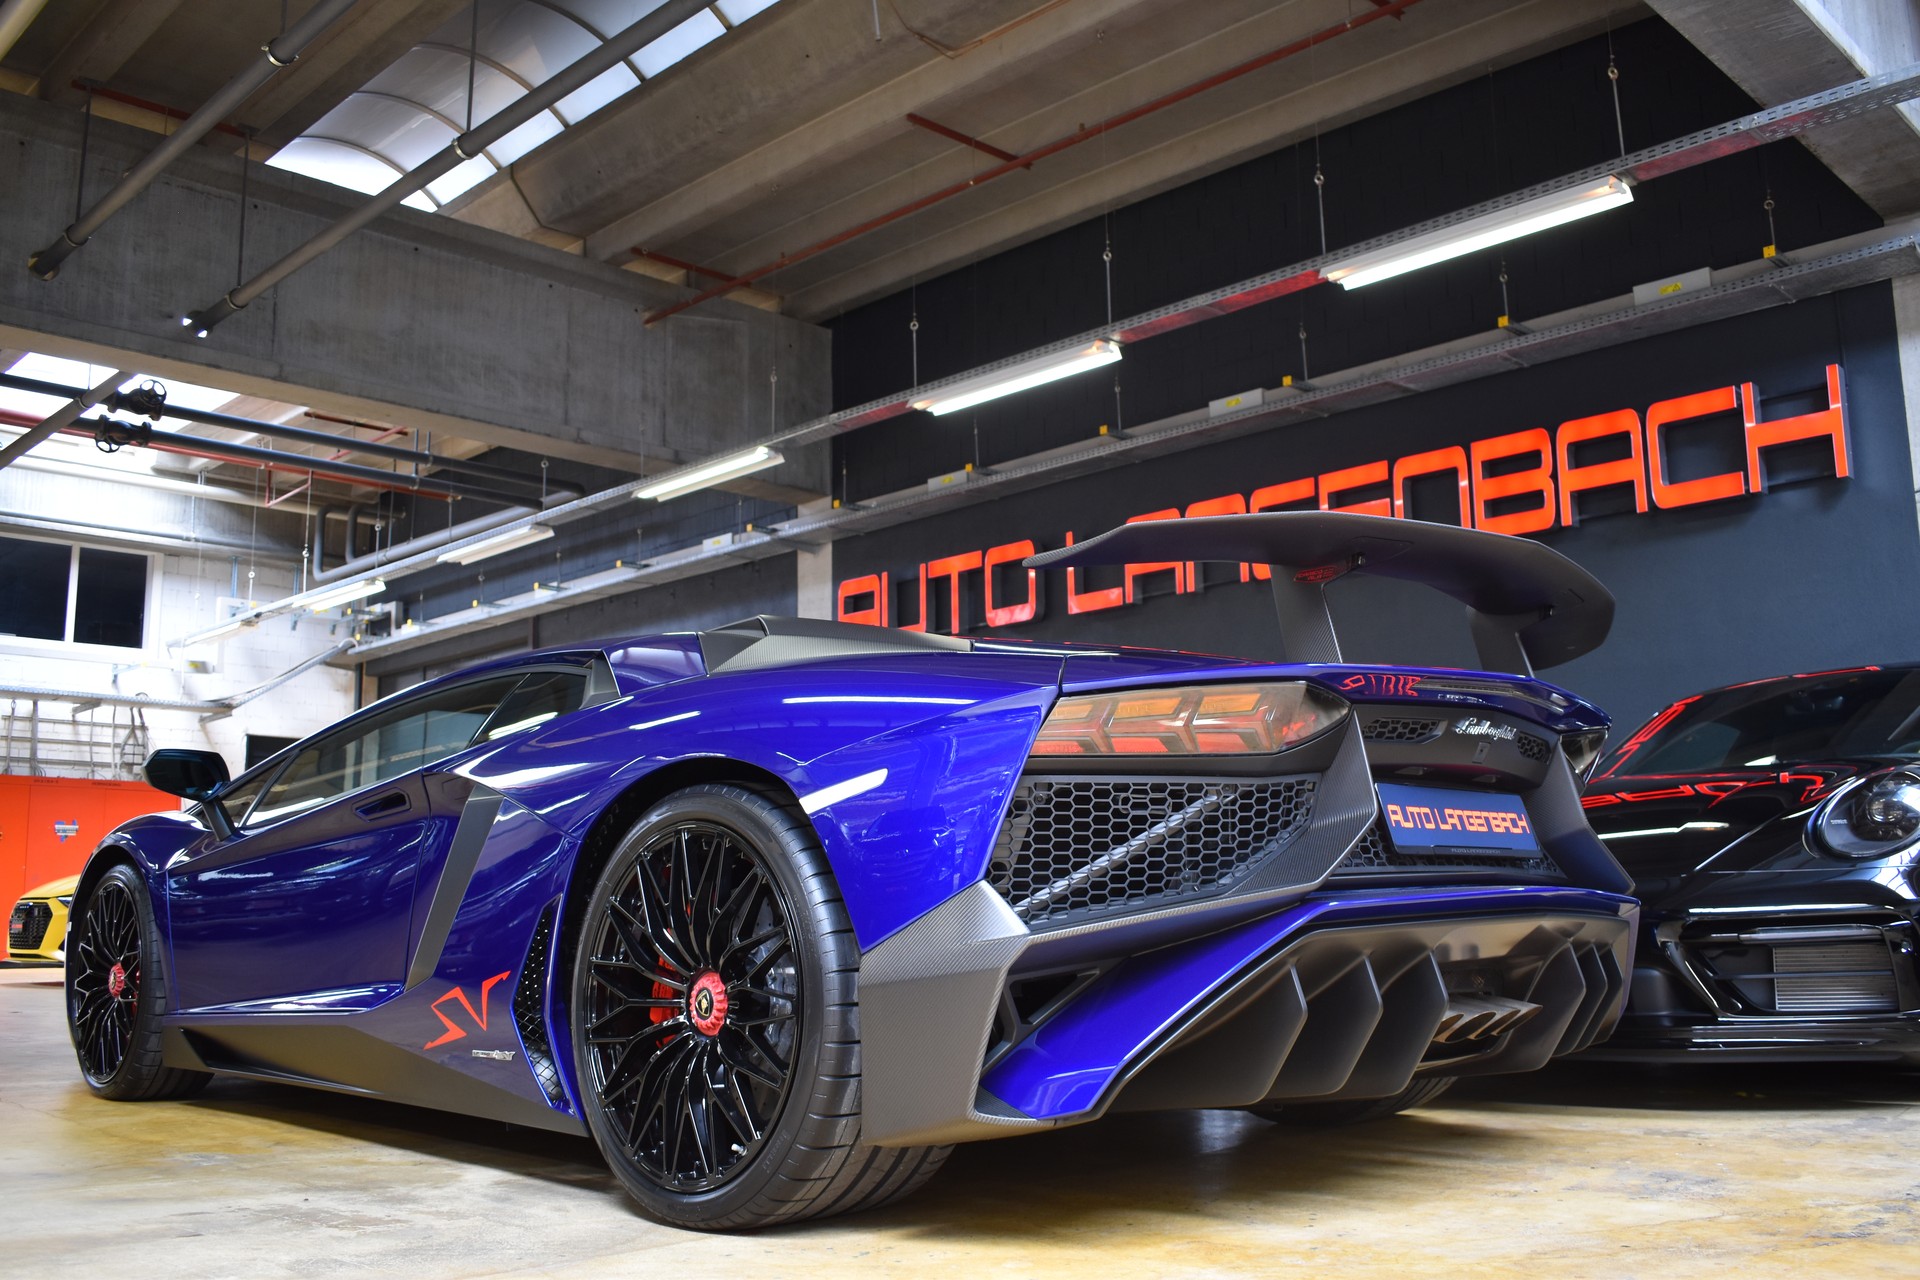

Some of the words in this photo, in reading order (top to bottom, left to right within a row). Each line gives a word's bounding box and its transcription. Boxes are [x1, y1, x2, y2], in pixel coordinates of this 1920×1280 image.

[837, 539, 1037, 635] AUTO
[1455, 717, 1517, 741] Lamborghini
[1387, 804, 1436, 830] AUTO
[1434, 808, 1531, 835] LANGENBACH
